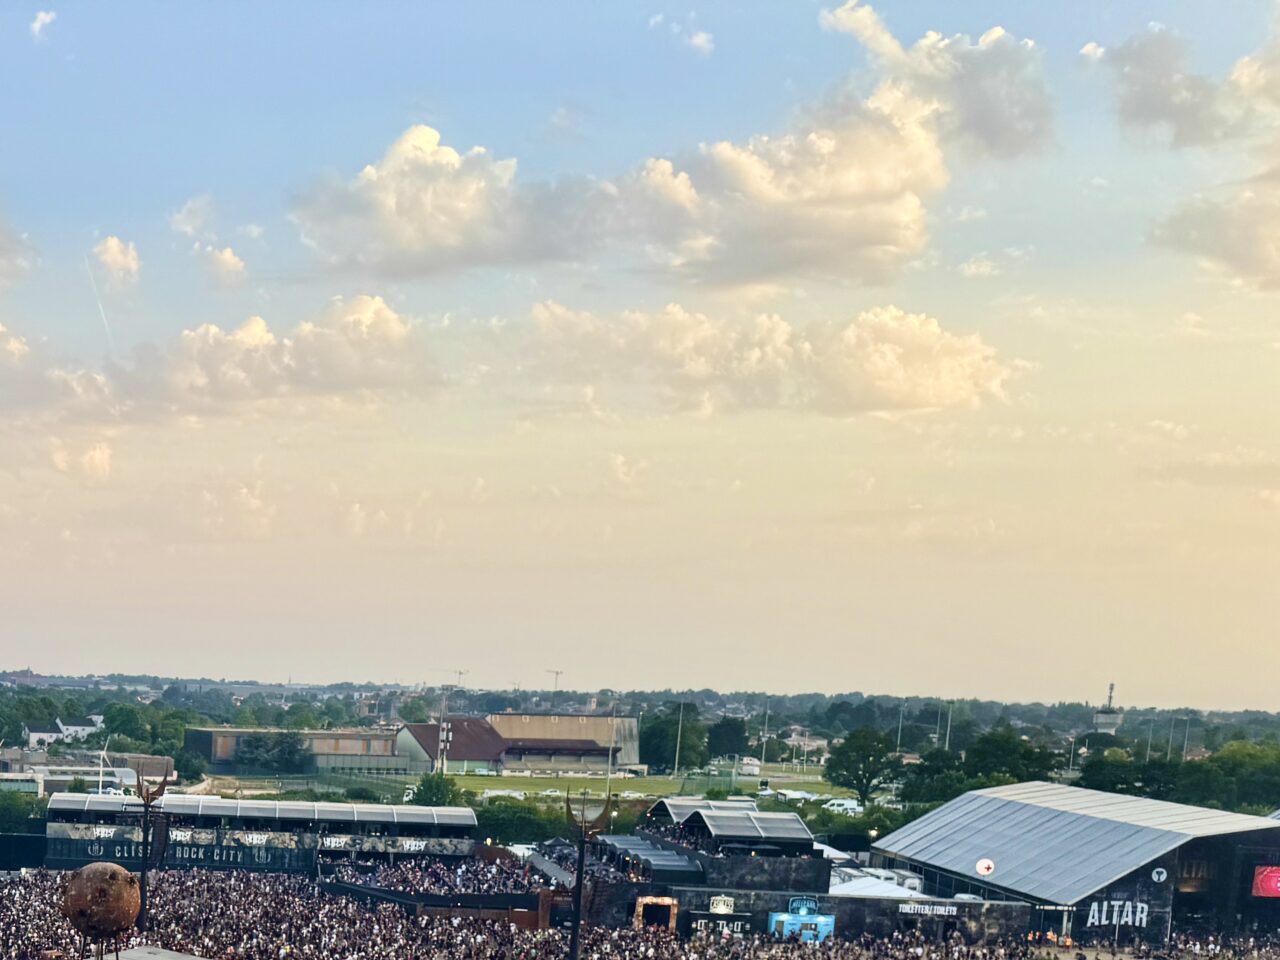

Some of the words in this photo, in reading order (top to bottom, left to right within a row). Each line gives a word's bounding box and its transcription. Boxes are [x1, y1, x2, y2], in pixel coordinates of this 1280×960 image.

[176, 847, 204, 859] ROCK
[214, 849, 243, 862] CITY
[934, 905, 957, 915] TOILETS
[1087, 900, 1149, 928] ALTAR
